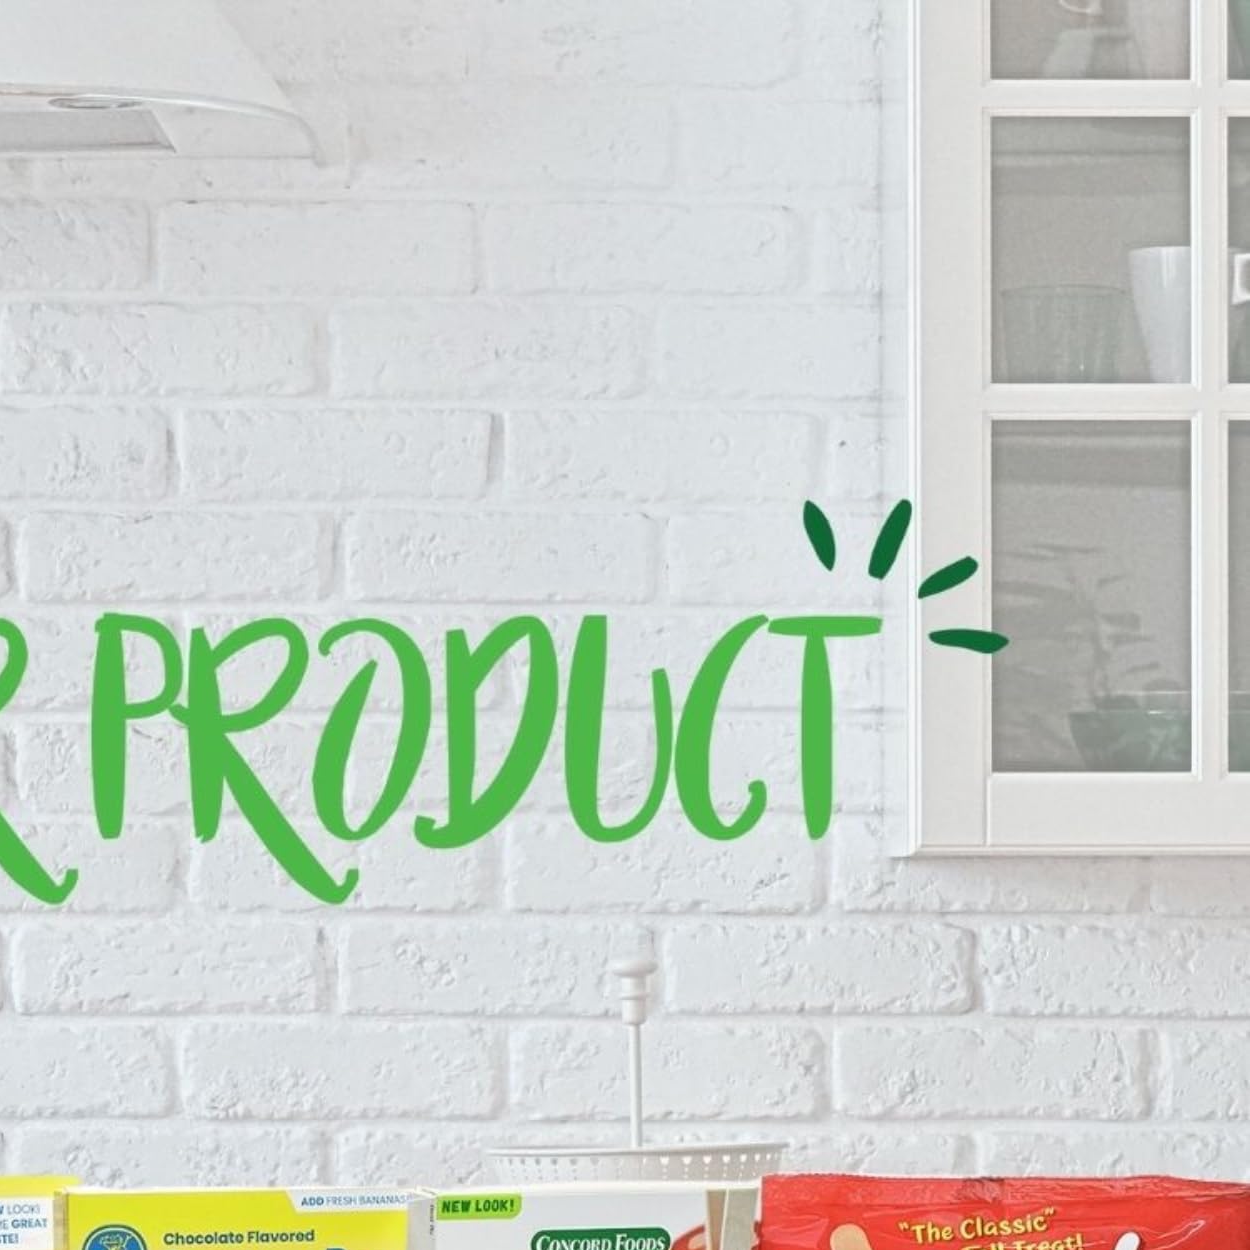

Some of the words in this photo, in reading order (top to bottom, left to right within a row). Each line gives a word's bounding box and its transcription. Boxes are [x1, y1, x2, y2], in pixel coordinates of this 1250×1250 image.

[301, 1196, 325, 1207] ADD
[441, 1200, 472, 1213] NEW
[475, 1197, 515, 1212] LOOK!
[11, 1218, 48, 1229] GREAT
[163, 1232, 244, 1246] Chocolate
[247, 1229, 315, 1244] Flavored
